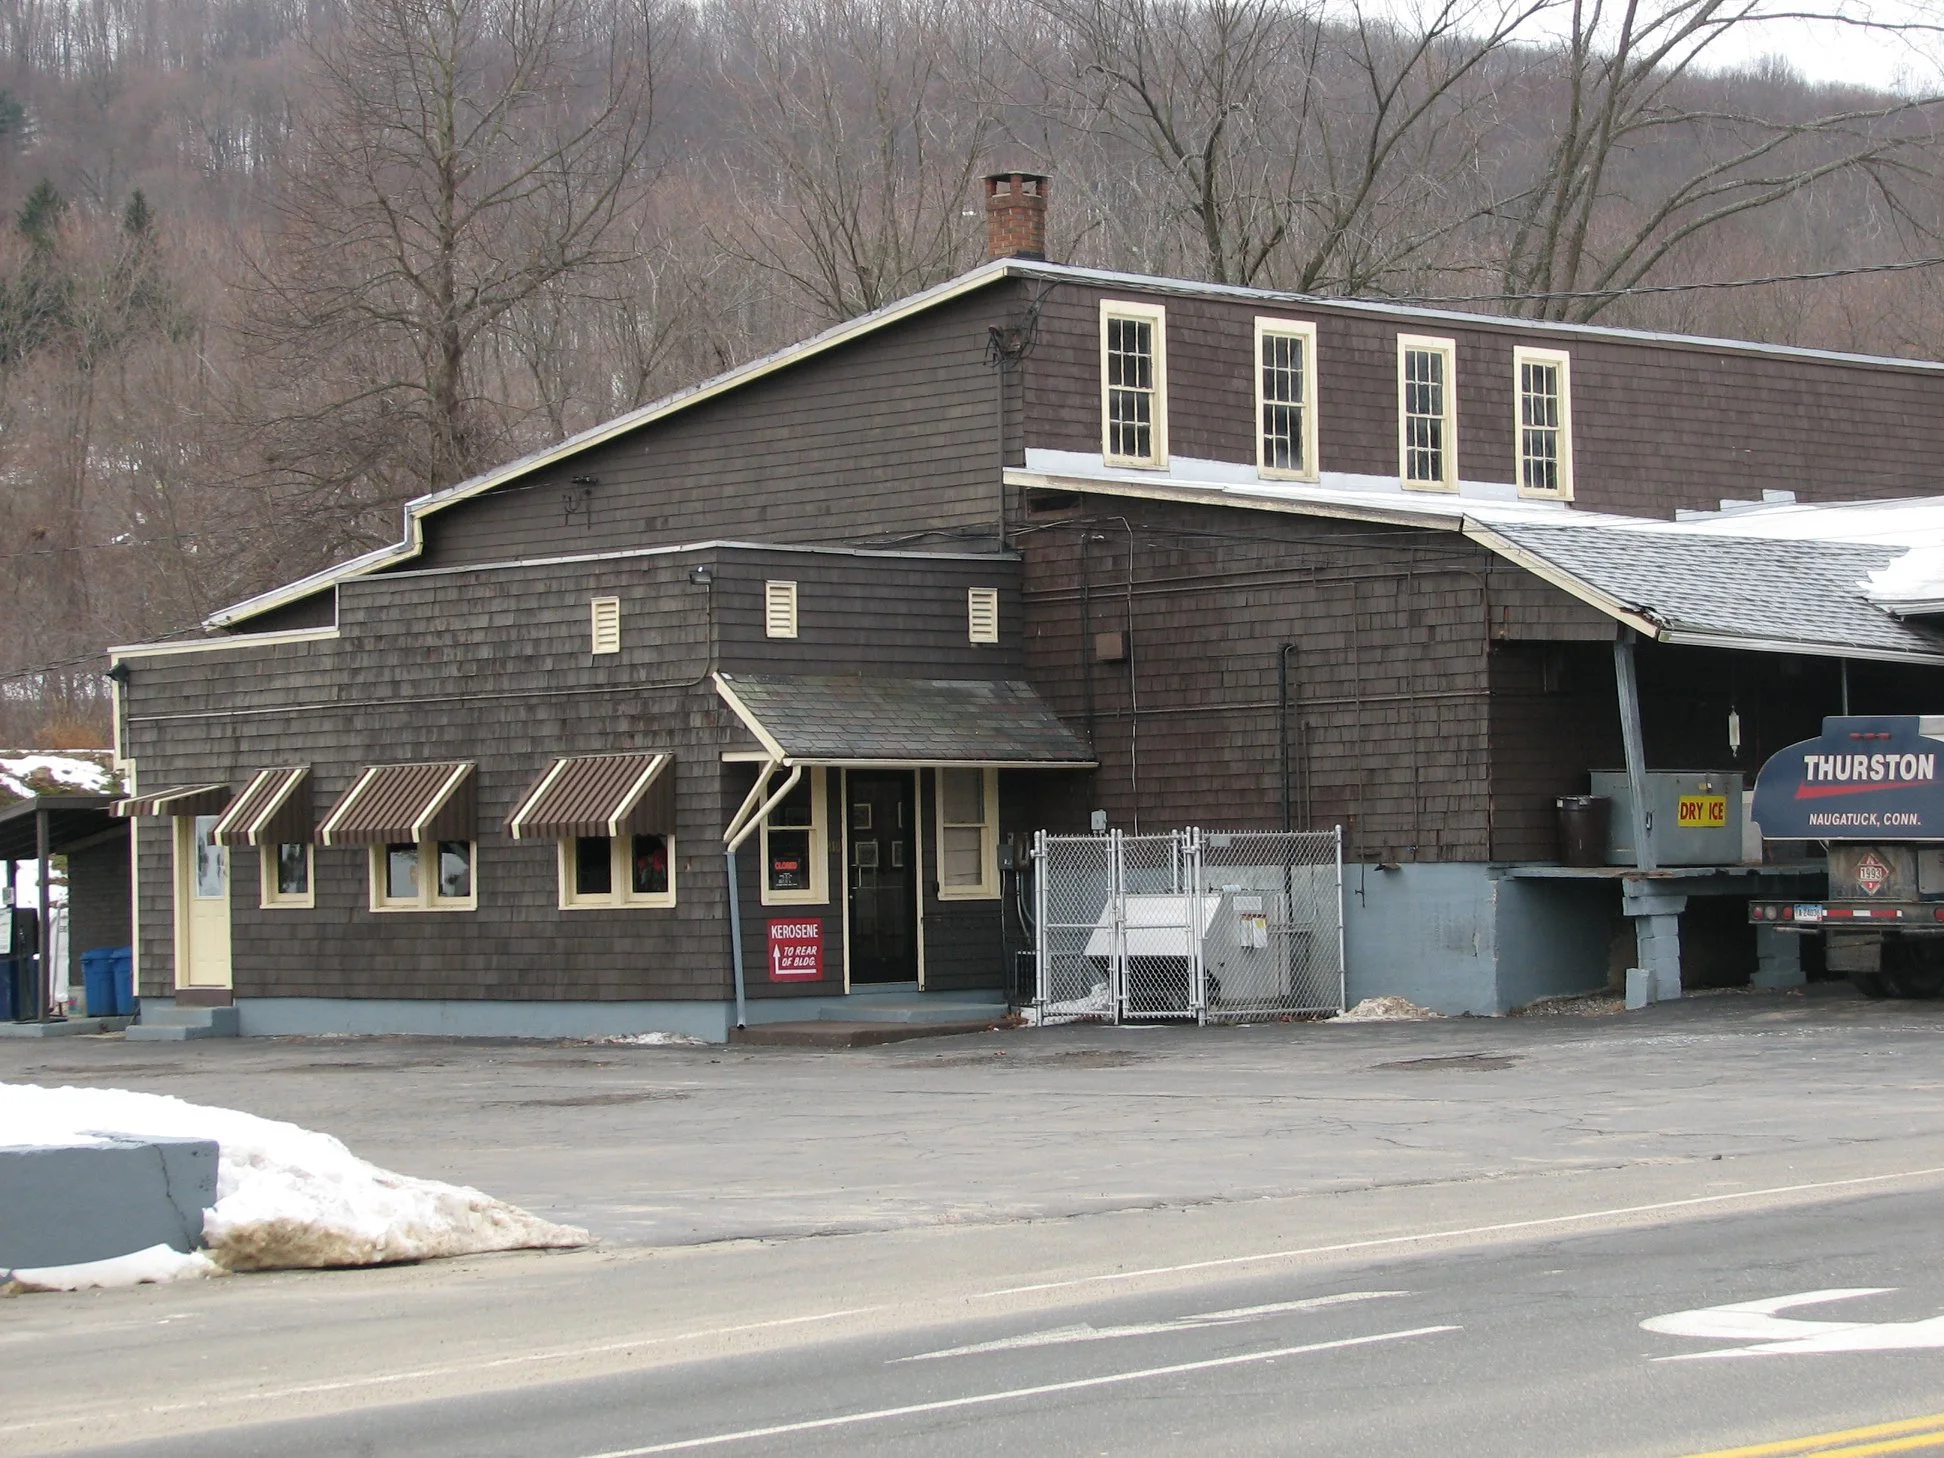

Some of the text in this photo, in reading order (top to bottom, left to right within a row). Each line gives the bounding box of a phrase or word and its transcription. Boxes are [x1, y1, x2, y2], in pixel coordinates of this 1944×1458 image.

[1803, 753, 1935, 781] THURSTON
[1680, 802, 1724, 820] DRY ICE
[1809, 813, 1921, 827] NAUGATUCK, CONN.
[1860, 866, 1881, 879] 1993
[771, 924, 819, 939] KEROSENE
[784, 946, 818, 956] TO REAR
[781, 957, 816, 967] OF BLDG.
